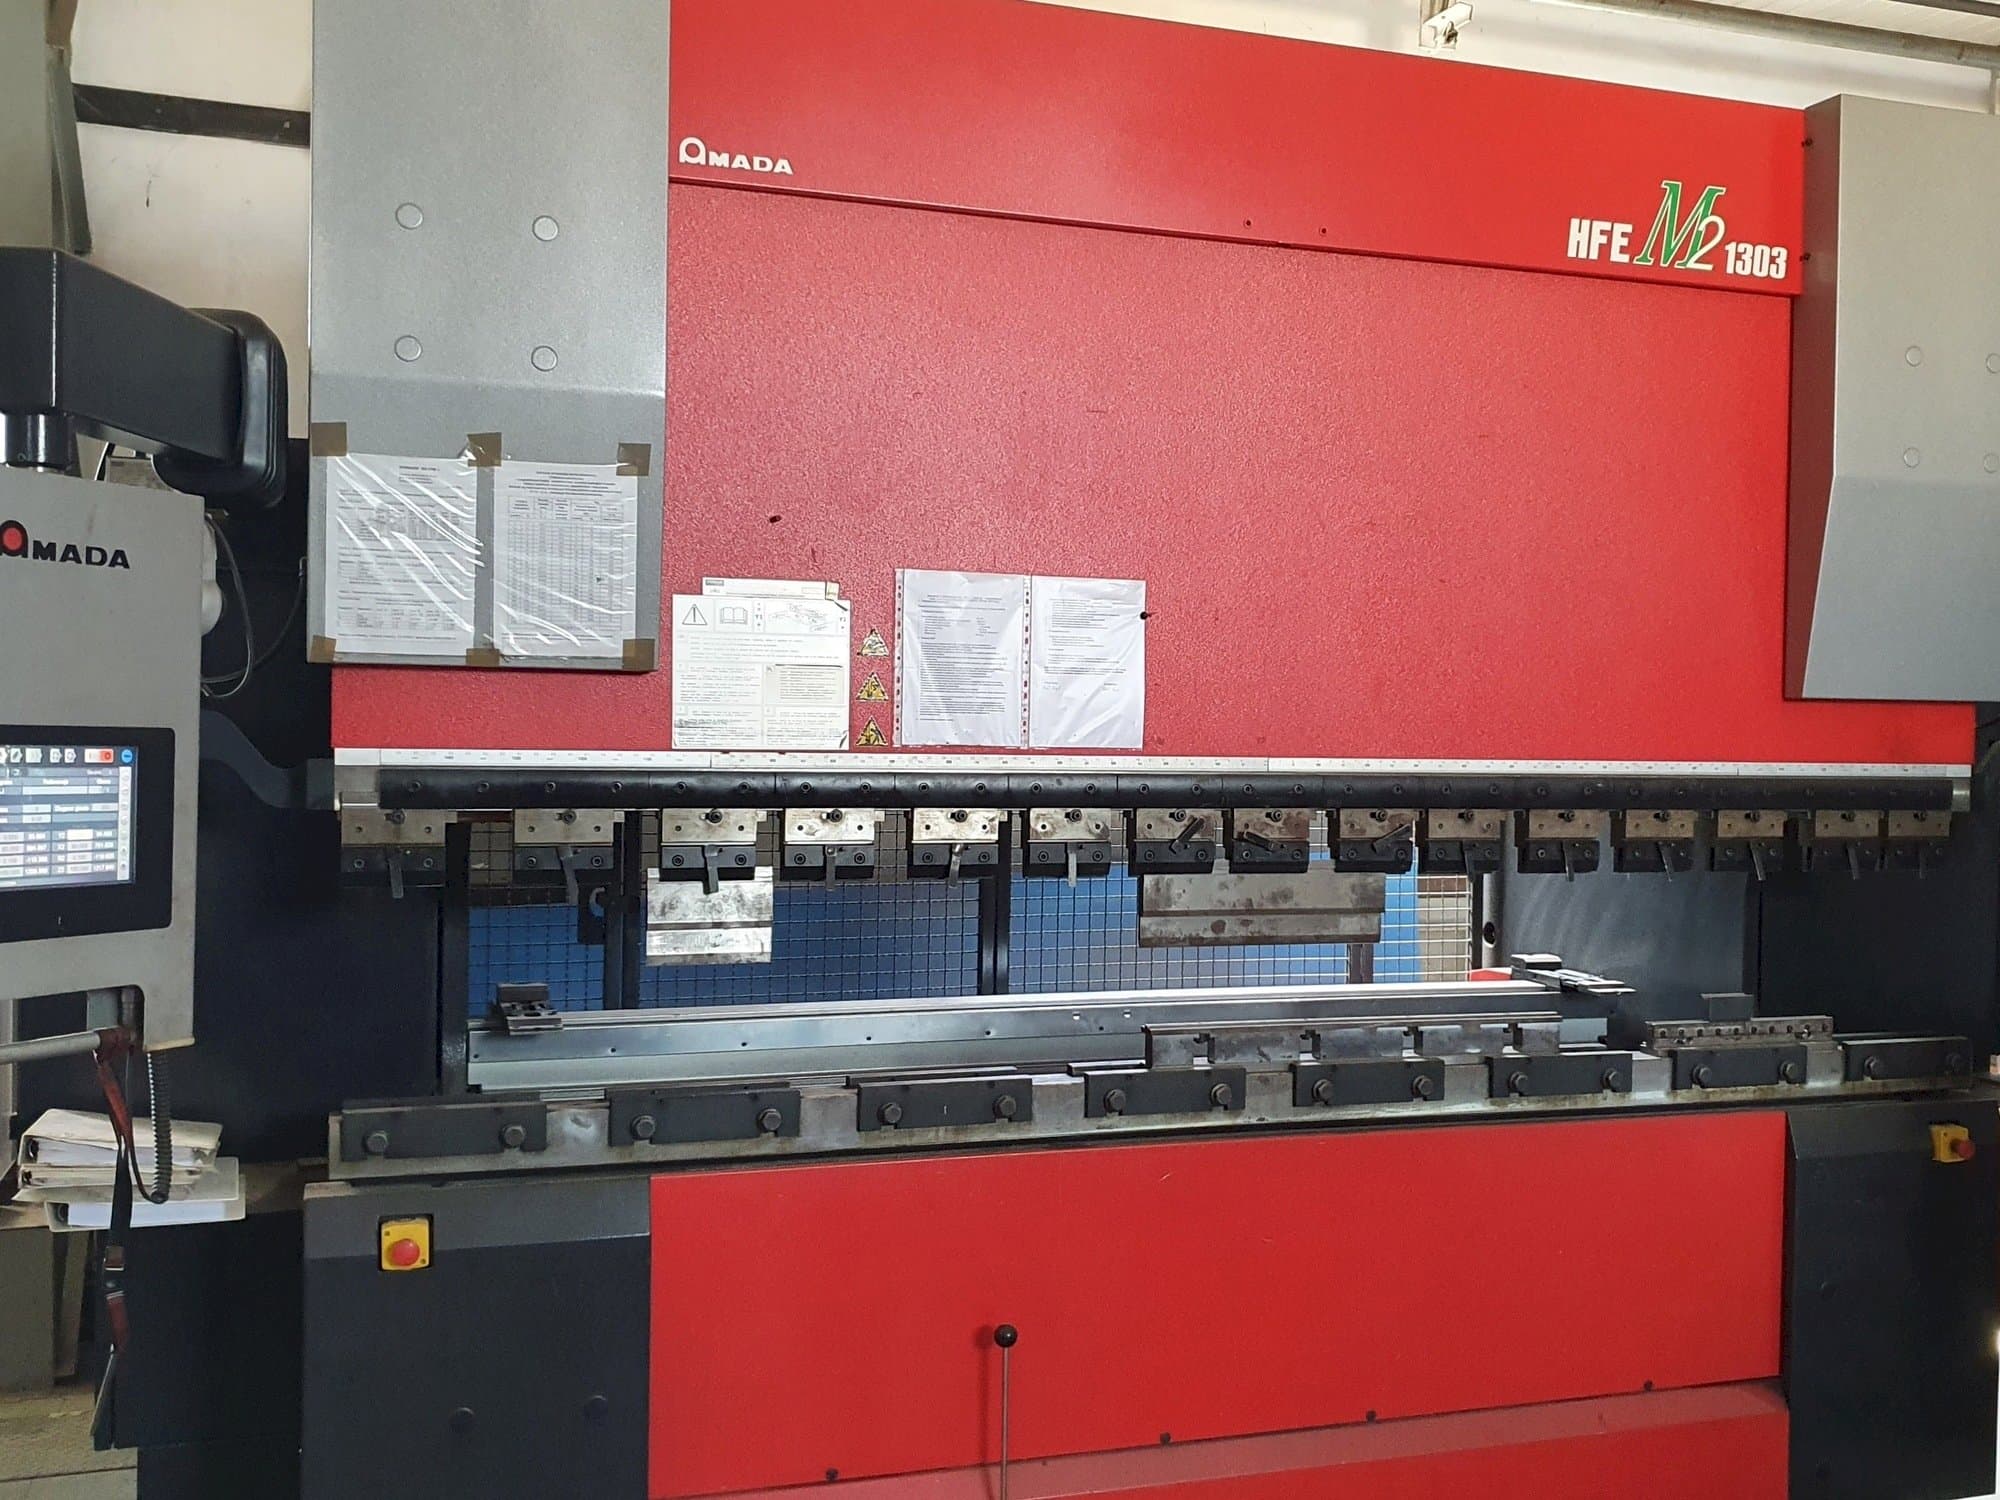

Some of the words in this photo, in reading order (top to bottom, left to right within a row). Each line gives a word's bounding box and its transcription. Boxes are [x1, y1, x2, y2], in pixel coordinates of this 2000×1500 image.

[678, 136, 794, 175] AMADA
[1566, 217, 1634, 264] HFE
[1723, 241, 1789, 280] 1303
[0, 519, 131, 570] AMADA
